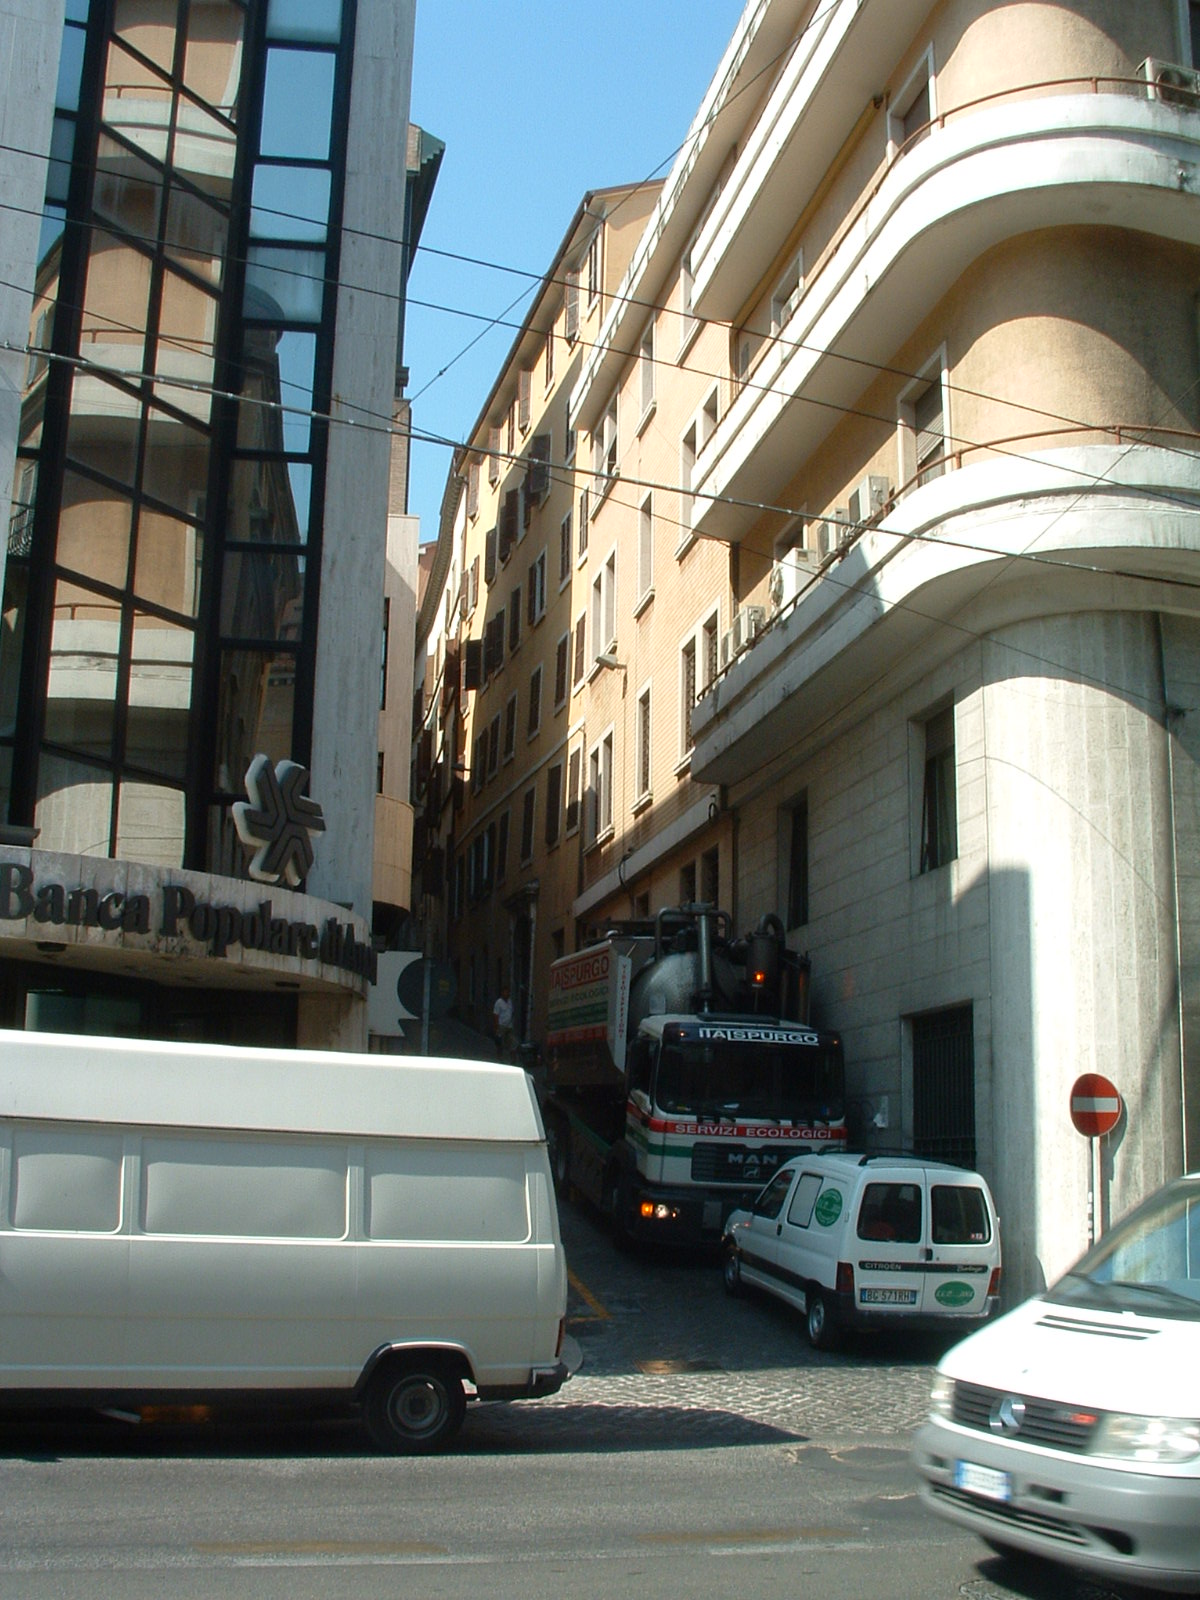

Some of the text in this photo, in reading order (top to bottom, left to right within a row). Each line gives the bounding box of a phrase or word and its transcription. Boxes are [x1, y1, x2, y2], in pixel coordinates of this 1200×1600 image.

[0, 862, 150, 935] Banca
[161, 886, 319, 959] Popolare
[675, 1124, 831, 1139] SERVIZI ECOLOGICI
[728, 1154, 777, 1164] MAN
